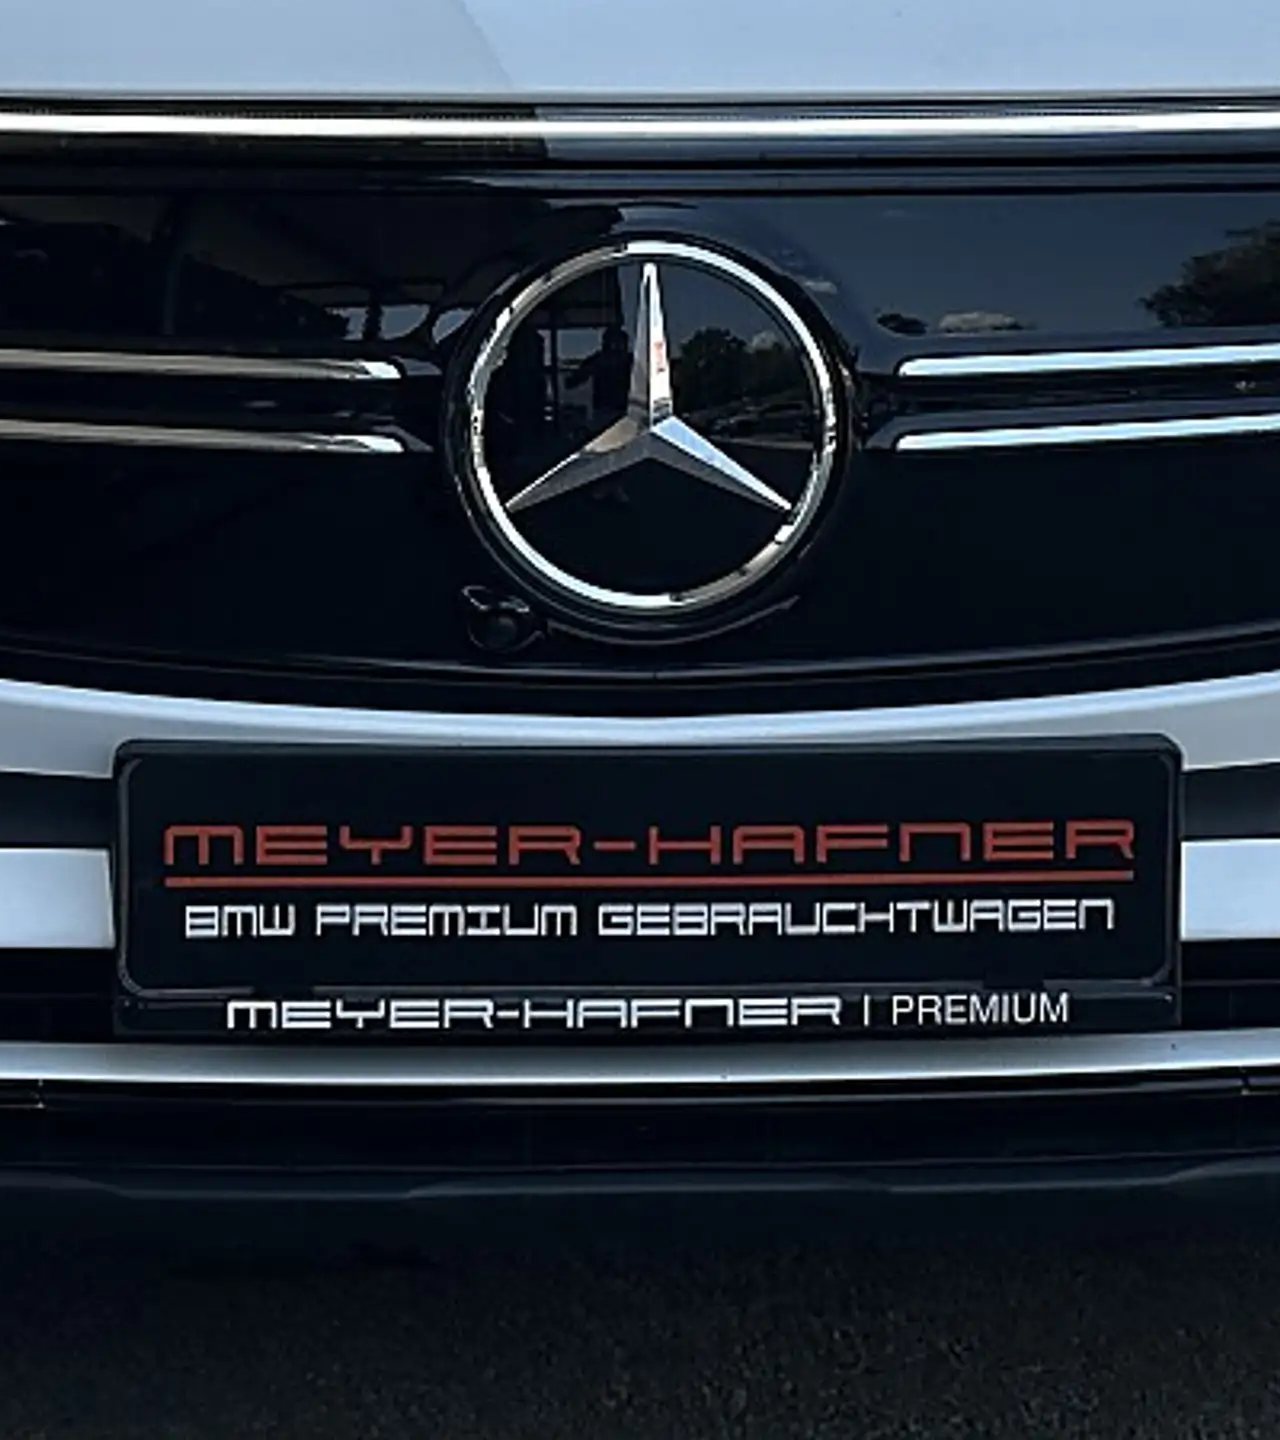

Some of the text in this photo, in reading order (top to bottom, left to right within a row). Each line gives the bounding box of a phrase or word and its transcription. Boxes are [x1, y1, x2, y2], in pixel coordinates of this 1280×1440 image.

[164, 821, 1134, 866] MEYER-HAFNER
[185, 898, 1114, 938] BMW PREMIUM GEBRAUCHTWAGEN
[227, 998, 841, 1029] MEYER-HAFNER
[892, 992, 1070, 1025] PREMIUM
